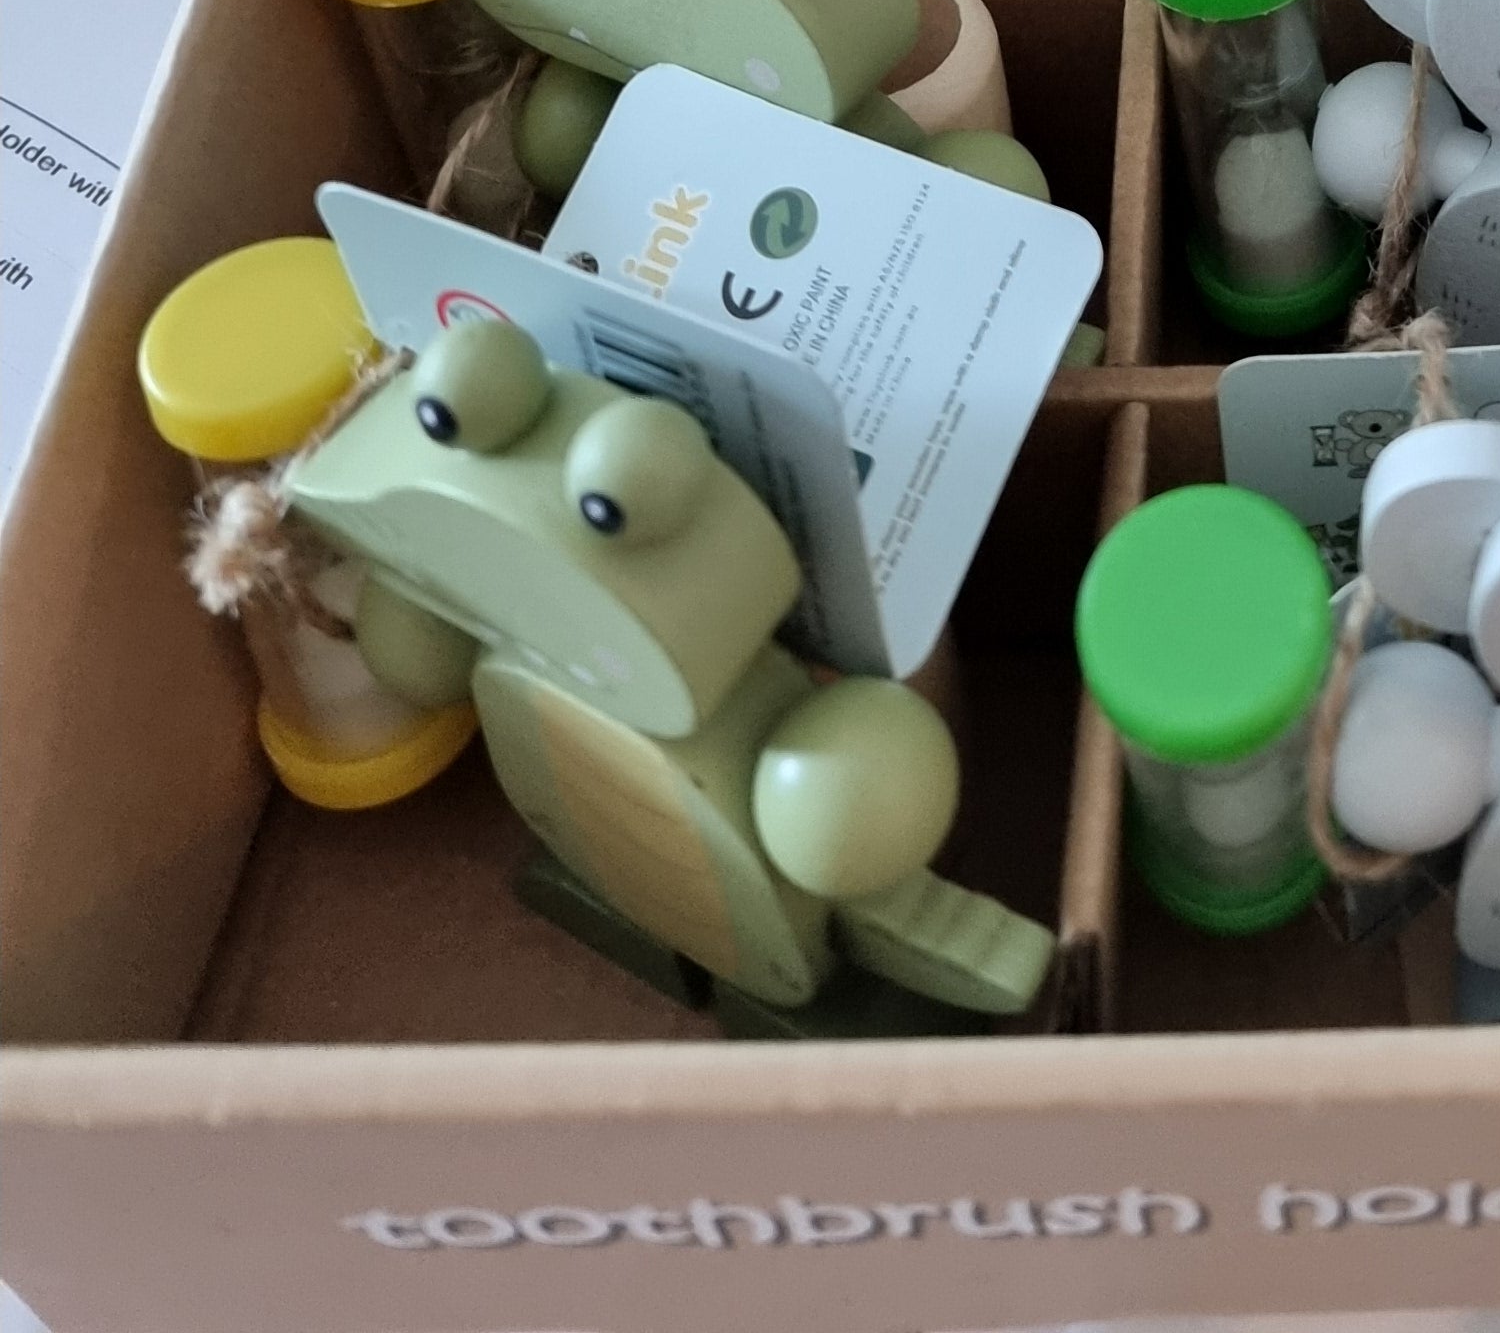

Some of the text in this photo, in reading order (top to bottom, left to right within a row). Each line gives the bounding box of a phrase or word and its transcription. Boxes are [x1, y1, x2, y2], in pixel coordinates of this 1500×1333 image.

[0, 125, 68, 179] older
[0, 257, 34, 292] ith
[346, 1181, 1210, 1253] toothbrush
